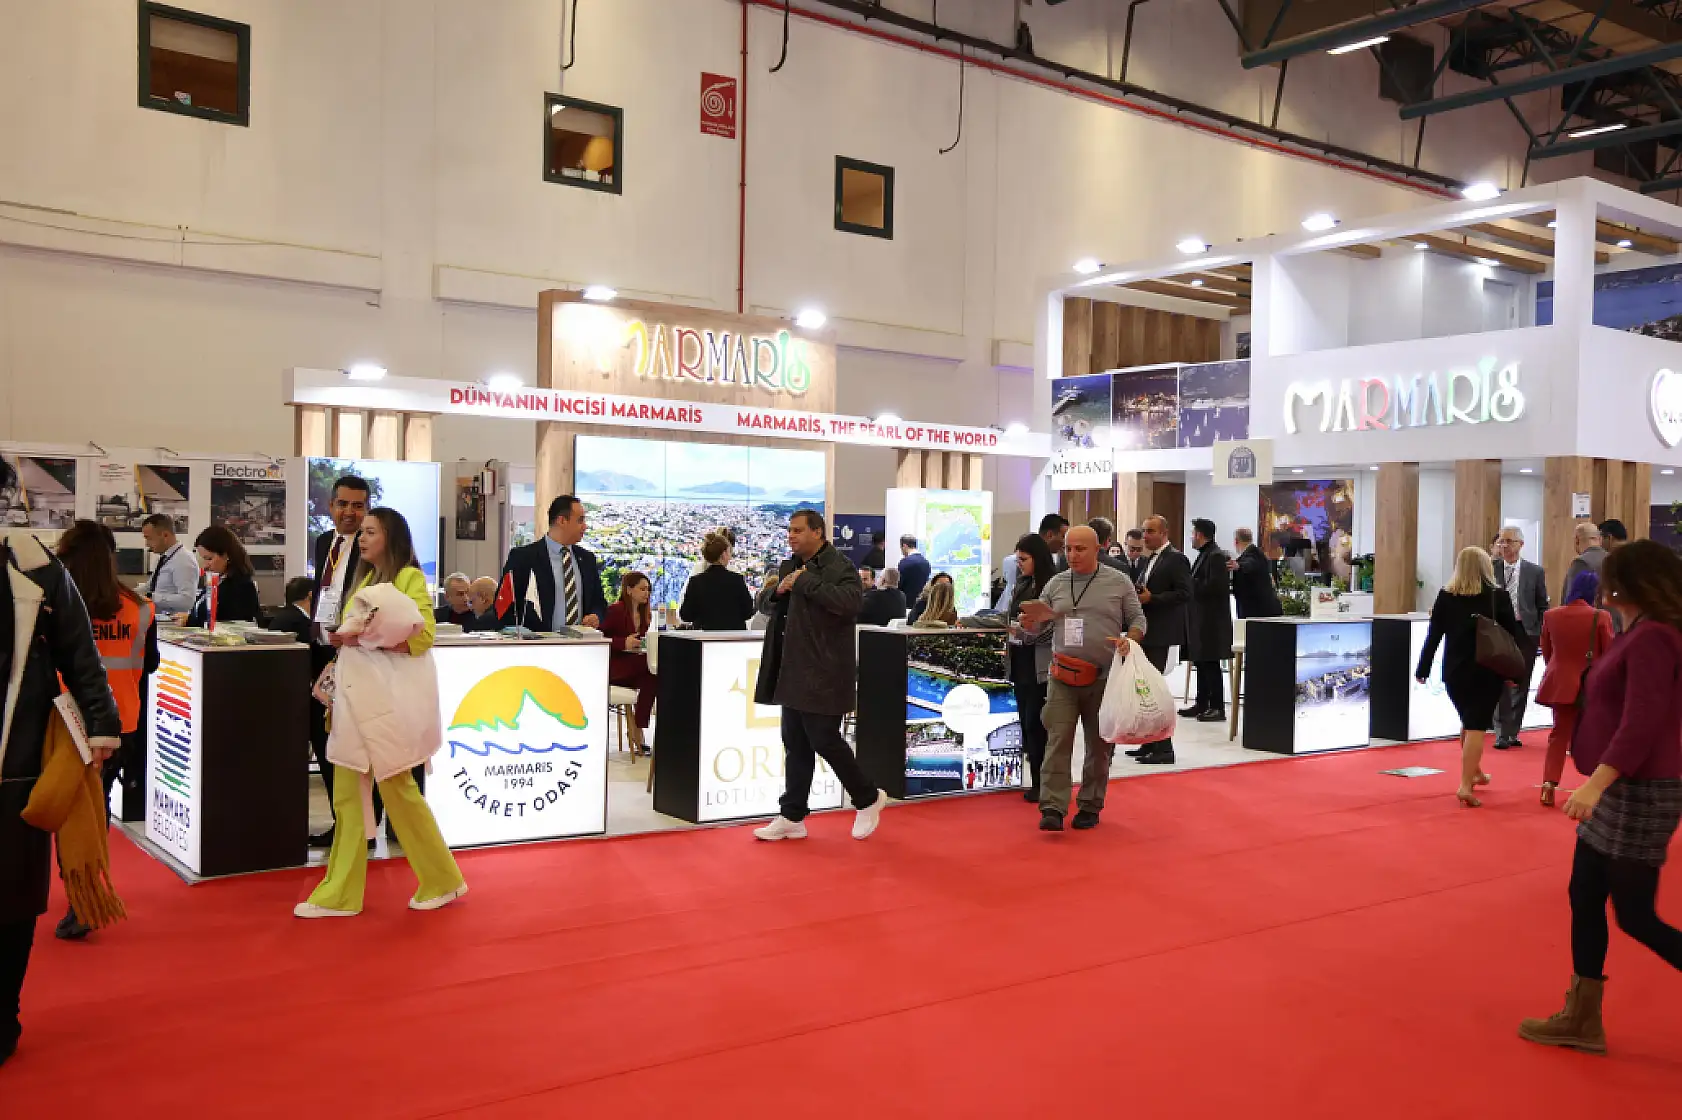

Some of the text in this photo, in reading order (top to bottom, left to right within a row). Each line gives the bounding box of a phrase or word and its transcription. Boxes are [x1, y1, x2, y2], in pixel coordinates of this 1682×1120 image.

[450, 386, 703, 424] DÜNYANIN İNCİSİ MARMARİS
[829, 419, 855, 436] THE
[905, 427, 924, 441] OF
[927, 429, 950, 444] THE
[953, 430, 997, 447] WORLD
[504, 777, 534, 789] 1994
[533, 760, 583, 812] ODASI
[706, 784, 767, 806] LOTUS
